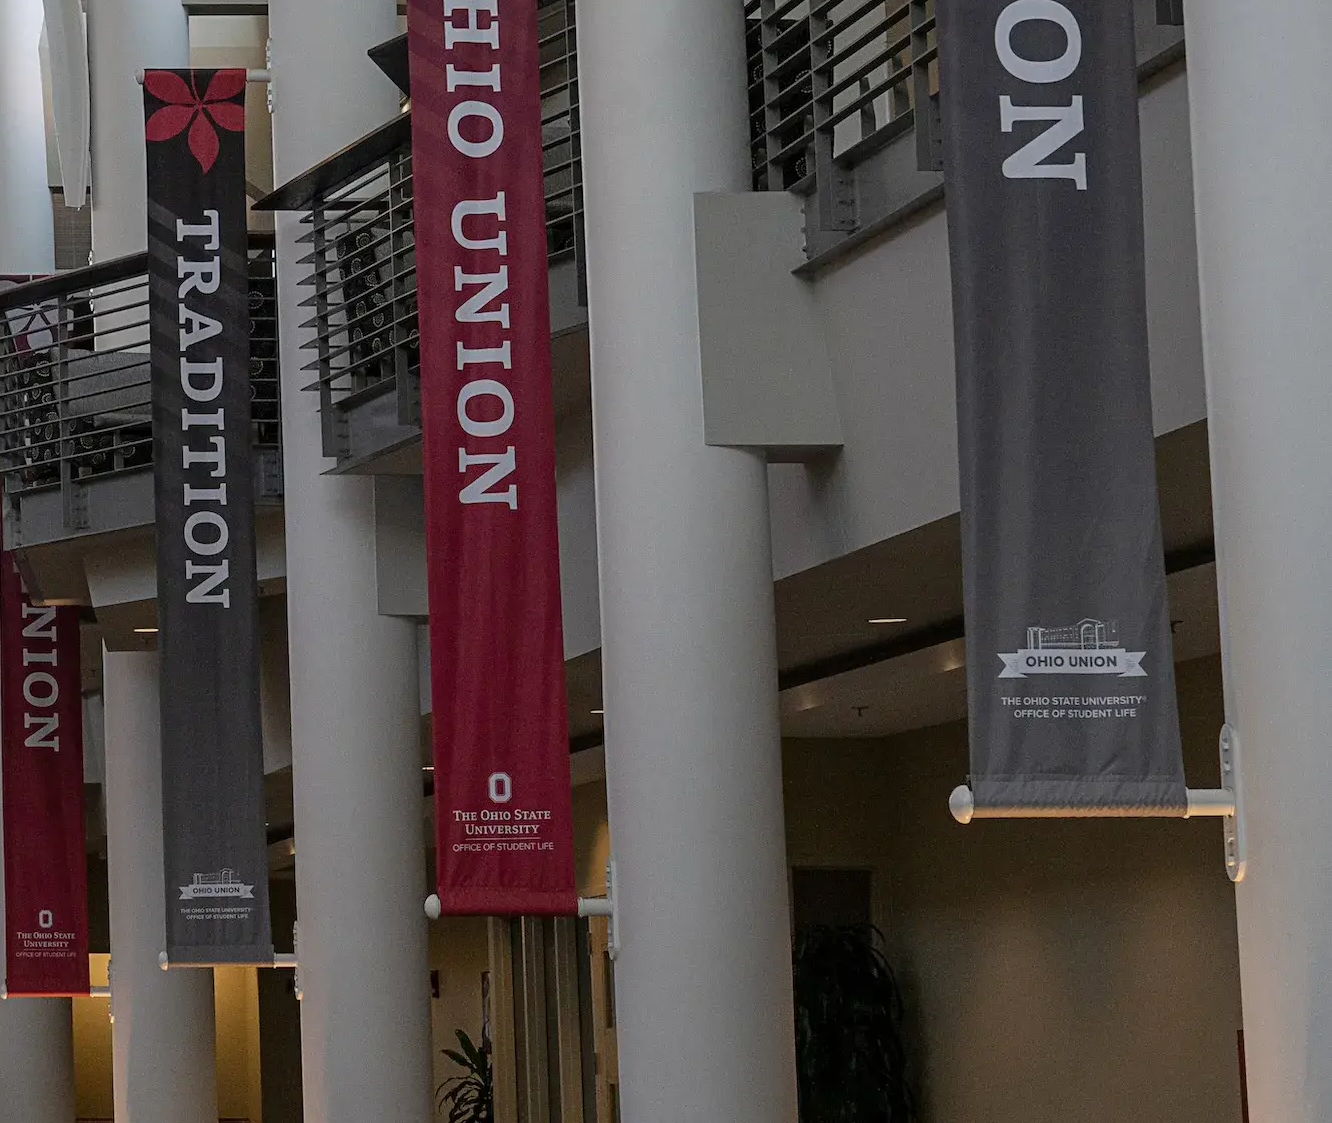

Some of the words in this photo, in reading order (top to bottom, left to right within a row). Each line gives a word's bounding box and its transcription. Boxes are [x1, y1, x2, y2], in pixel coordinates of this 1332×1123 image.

[451, 191, 518, 510] UNION
[175, 209, 230, 609] TRADITION
[21, 579, 60, 753] NION
[1026, 656, 1064, 668] OHIO
[1069, 656, 1117, 668] UNION
[1001, 697, 1022, 706] THE
[1023, 697, 1050, 706] OHIO
[1052, 697, 1080, 706] STATE
[1014, 709, 1050, 718] OFFICE
[1052, 709, 1066, 718] OF
[1068, 709, 1112, 718] STUDENT
[1115, 708, 1136, 718] LIFE
[488, 772, 512, 804] O
[452, 810, 477, 821] THE
[480, 809, 511, 820] OHIO
[514, 809, 551, 820] STATE
[465, 824, 540, 836] UNIVERSITY
[452, 843, 482, 852] OFFICE
[483, 843, 496, 852] OF
[497, 842, 536, 851] STUDENT
[538, 842, 554, 850] LIFE
